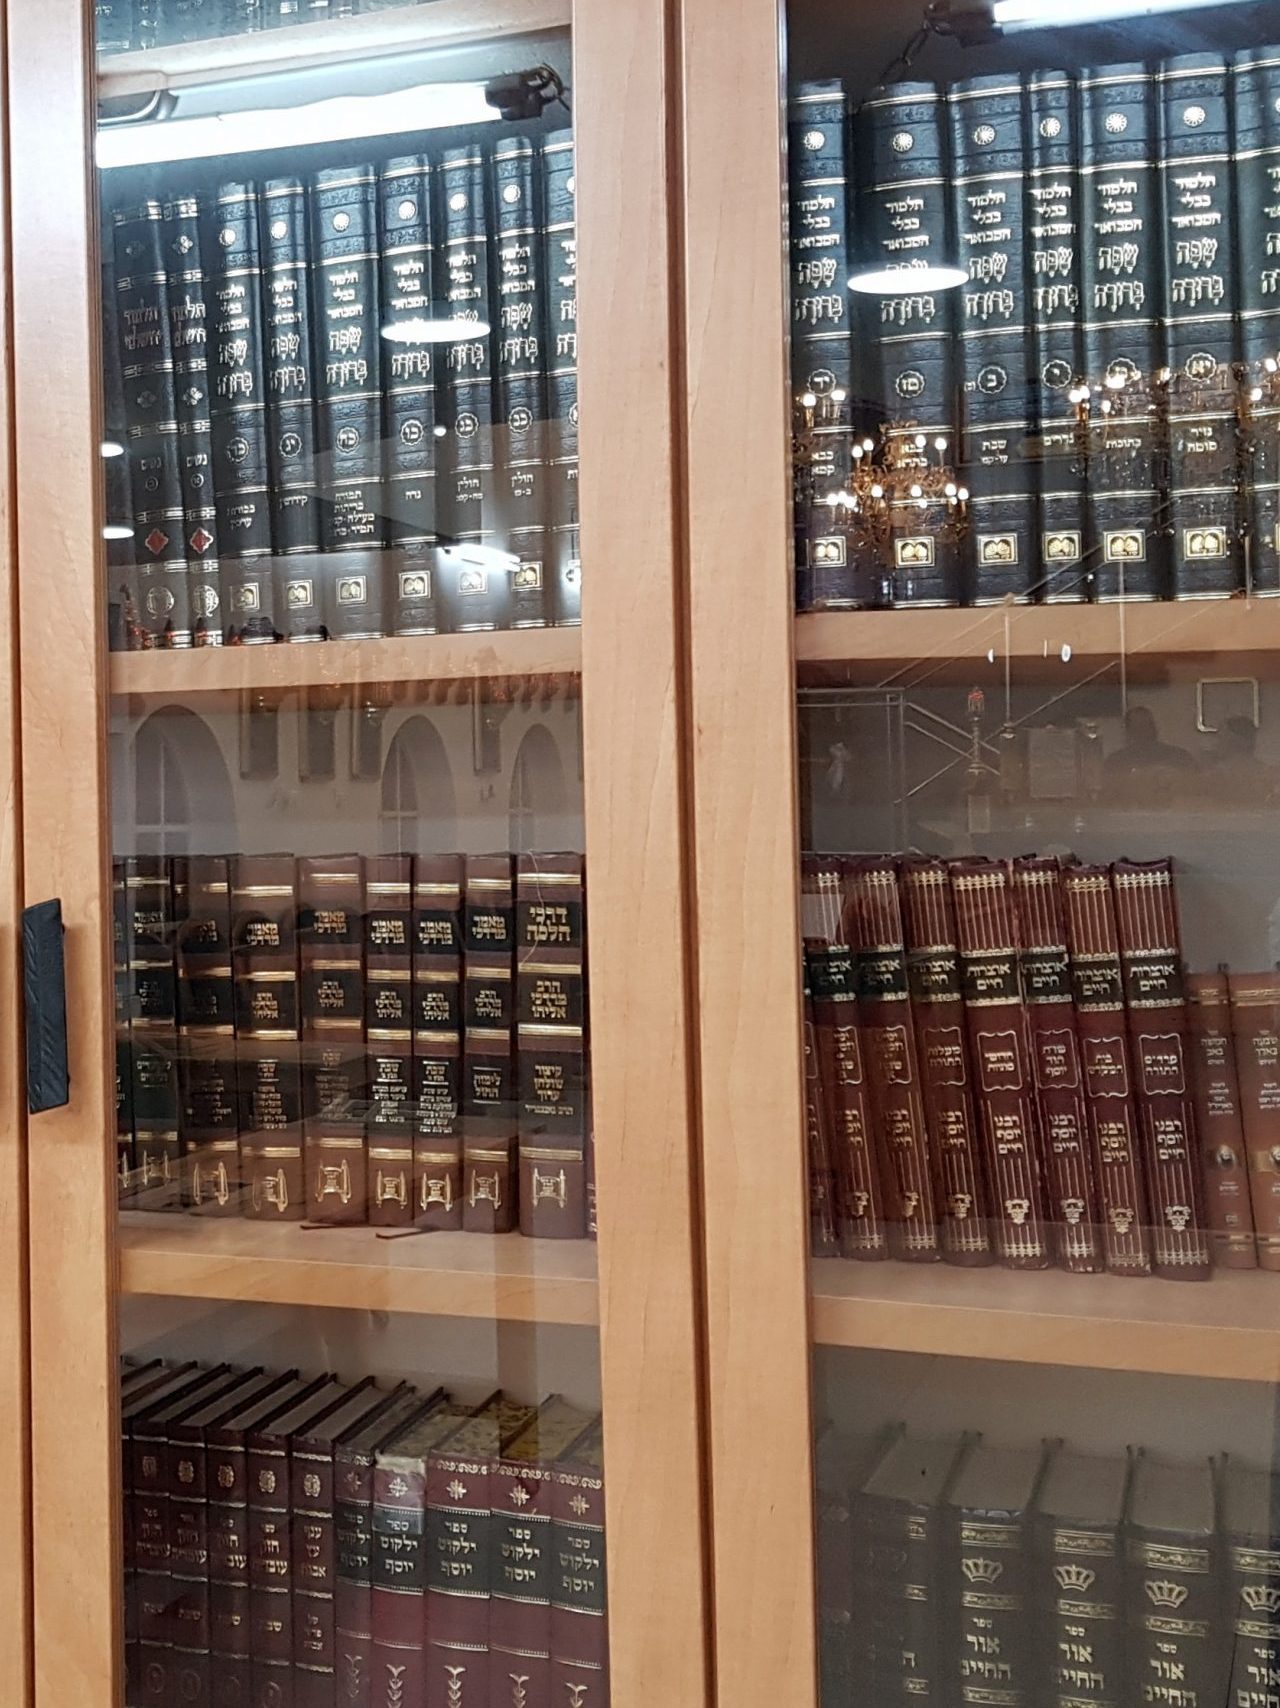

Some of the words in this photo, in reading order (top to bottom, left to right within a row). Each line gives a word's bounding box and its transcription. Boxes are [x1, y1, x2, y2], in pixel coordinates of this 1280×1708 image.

[982, 440, 1007, 451] שבת
[457, 477, 480, 491] חולין
[511, 472, 534, 487] חולין
[314, 911, 345, 922] מאמר
[473, 915, 505, 928] מאמר
[529, 906, 568, 924] דרכי
[247, 923, 278, 935] מאמר
[314, 922, 347, 933] מרדכי
[372, 920, 403, 933] מאמר
[420, 921, 452, 934] מאמר
[526, 920, 571, 942] הלכה
[246, 935, 279, 945] מרדכי
[371, 932, 405, 944] מרדכי
[418, 932, 453, 945] מרדכי
[472, 927, 507, 940] מרדכי
[967, 964, 1011, 978] אוצרות
[1075, 968, 1118, 982] אוצרות
[1129, 964, 1175, 978] אוצרות
[536, 980, 561, 992] הרב
[976, 977, 1005, 990] חיים
[1032, 975, 1060, 988] חיים
[1139, 979, 1168, 992] חיים
[1082, 982, 1111, 995] חיים
[530, 992, 568, 1007] מרדכי
[531, 1005, 567, 1019] אליהו
[1095, 1054, 1113, 1064] בית
[379, 1063, 399, 1072] שבת
[426, 1066, 445, 1075] שבת
[534, 1065, 562, 1078] קיצור
[1144, 1066, 1179, 1077] התורה
[533, 1077, 564, 1091] שולחן
[536, 1089, 561, 1102] ערוך
[996, 1128, 1022, 1143] יוסף
[1051, 1127, 1078, 1141] יוסף
[1157, 1133, 1184, 1147] יוסף
[998, 1142, 1024, 1155] חיים
[1053, 1141, 1080, 1154] חיים
[1101, 1136, 1128, 1150] יוסף
[1102, 1150, 1130, 1162] חיים
[1159, 1147, 1187, 1160] חיים
[385, 1519, 410, 1532] ספר
[444, 1521, 468, 1534] ספר
[507, 1526, 531, 1540] ספר
[379, 1534, 419, 1554] ילקוט
[437, 1536, 478, 1556] ילקוט
[567, 1536, 591, 1549] ספר
[500, 1542, 541, 1562] ילקוט
[384, 1559, 415, 1576] יוסף
[559, 1552, 600, 1571] ילקוט
[440, 1560, 473, 1577] יוסף
[503, 1565, 537, 1582] יוסף
[561, 1575, 595, 1592] יוסף
[972, 1618, 992, 1628] ספר
[1065, 1625, 1085, 1637] ספר
[967, 1634, 1000, 1654] אור
[1156, 1642, 1177, 1654] ספר
[1059, 1643, 1093, 1663] אור
[1150, 1660, 1185, 1680] אור
[1237, 1689, 1280, 1708] חיים
